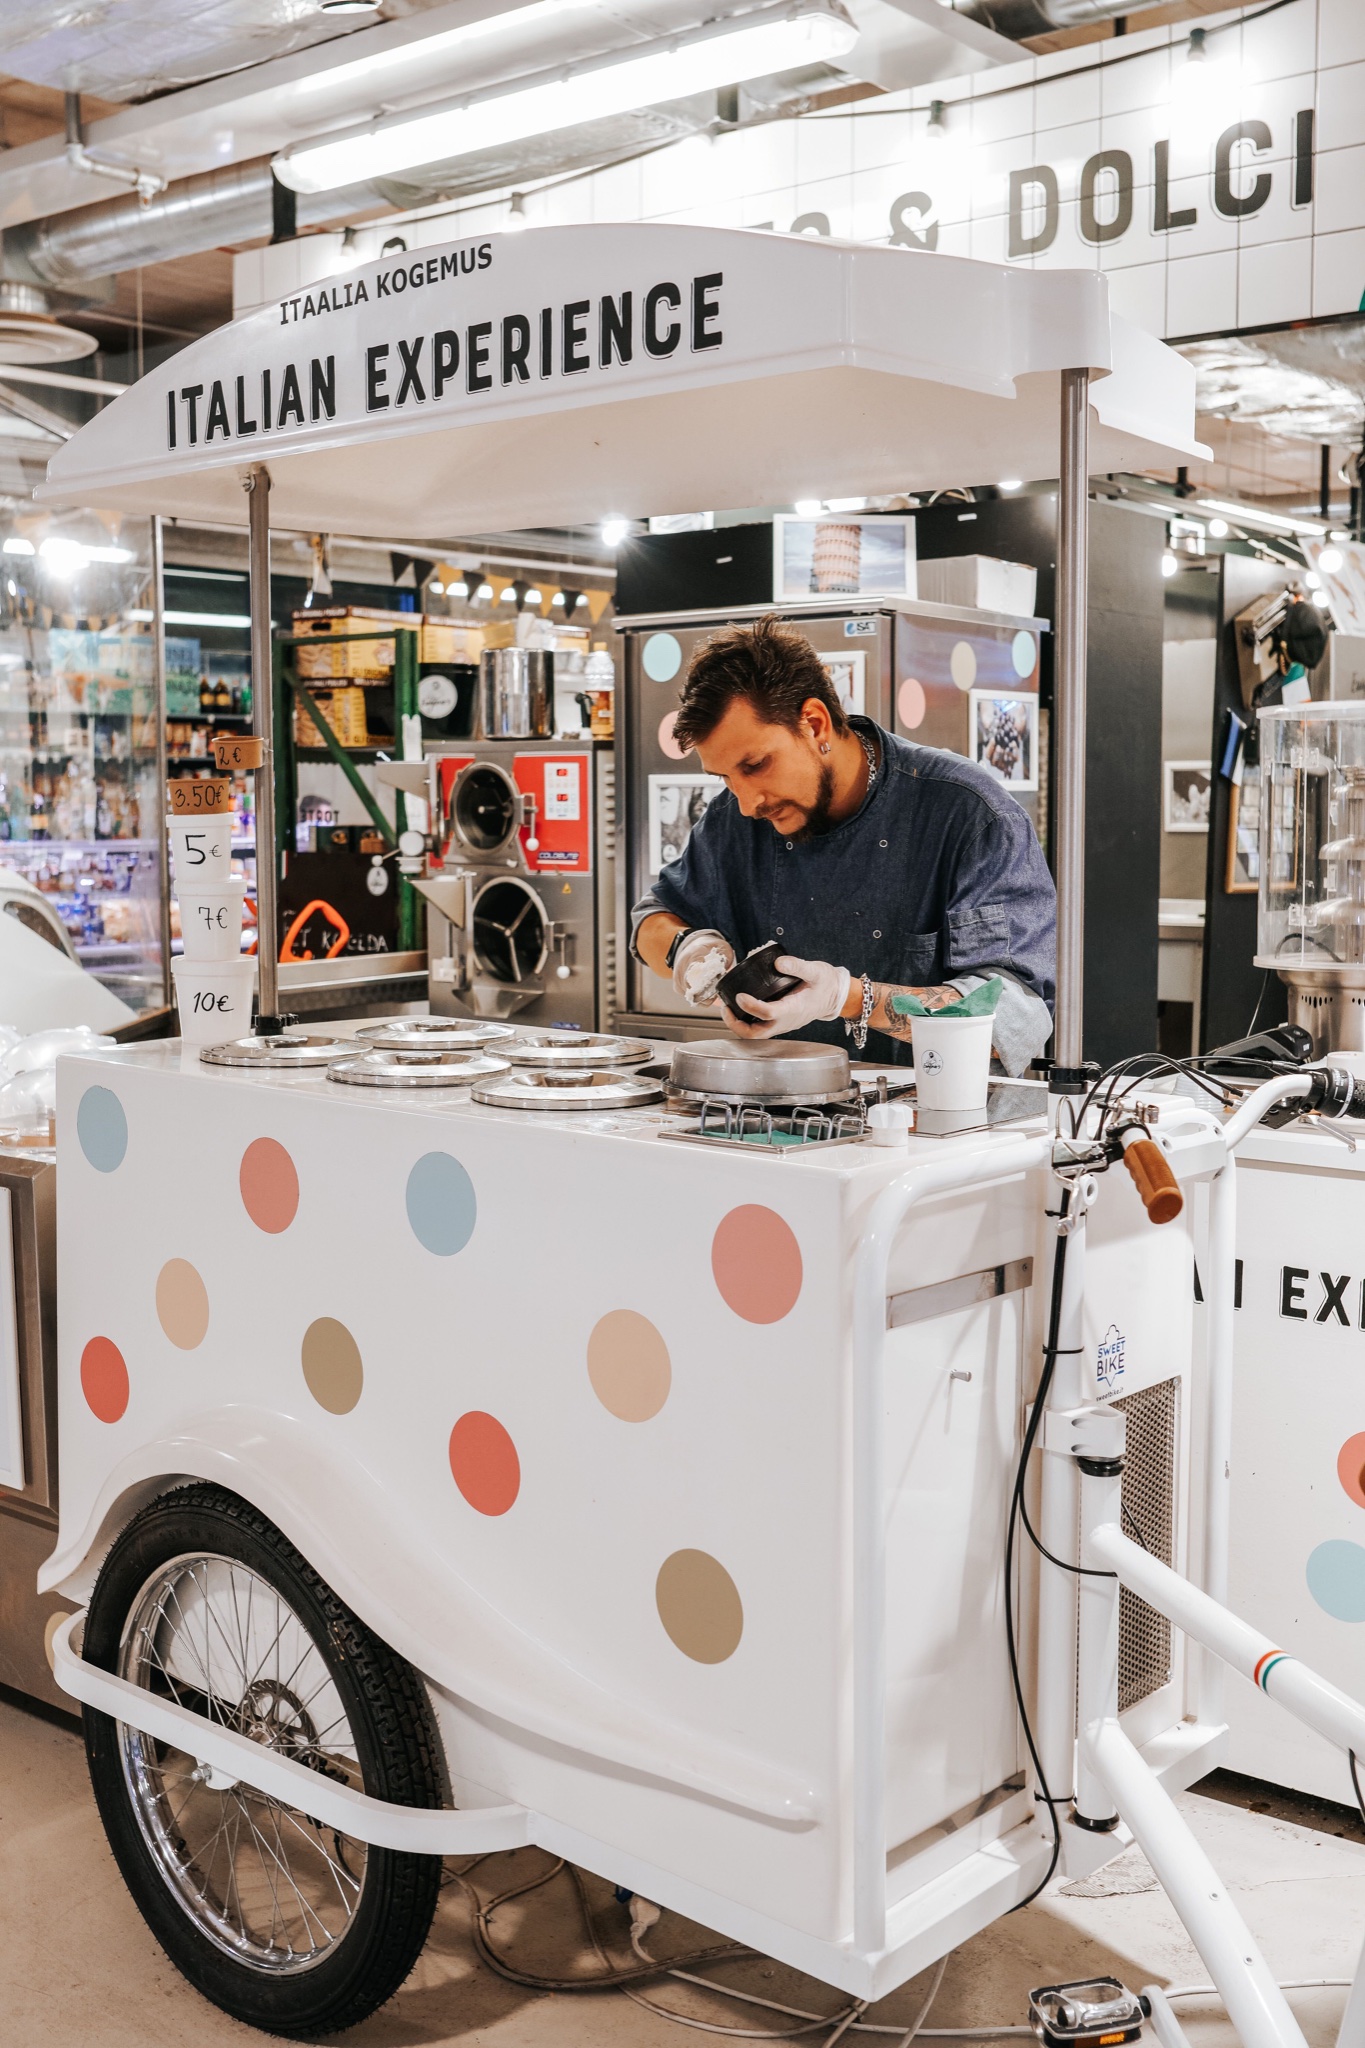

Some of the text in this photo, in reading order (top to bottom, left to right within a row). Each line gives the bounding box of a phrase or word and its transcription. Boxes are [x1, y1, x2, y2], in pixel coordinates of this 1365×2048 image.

[1005, 108, 1314, 261] DOLCI
[279, 279, 370, 326] ITAALIA
[376, 243, 494, 299] KOGEMUS
[166, 272, 724, 450] ITALIAN EXPERIENCE
[174, 785, 225, 808] 3.50€
[198, 906, 229, 930] 7€
[193, 992, 235, 1014] 10€
[1279, 1265, 1365, 1333] EX
[1097, 1340, 1126, 1358] SWEET
[1096, 1352, 1125, 1377] BIKE
